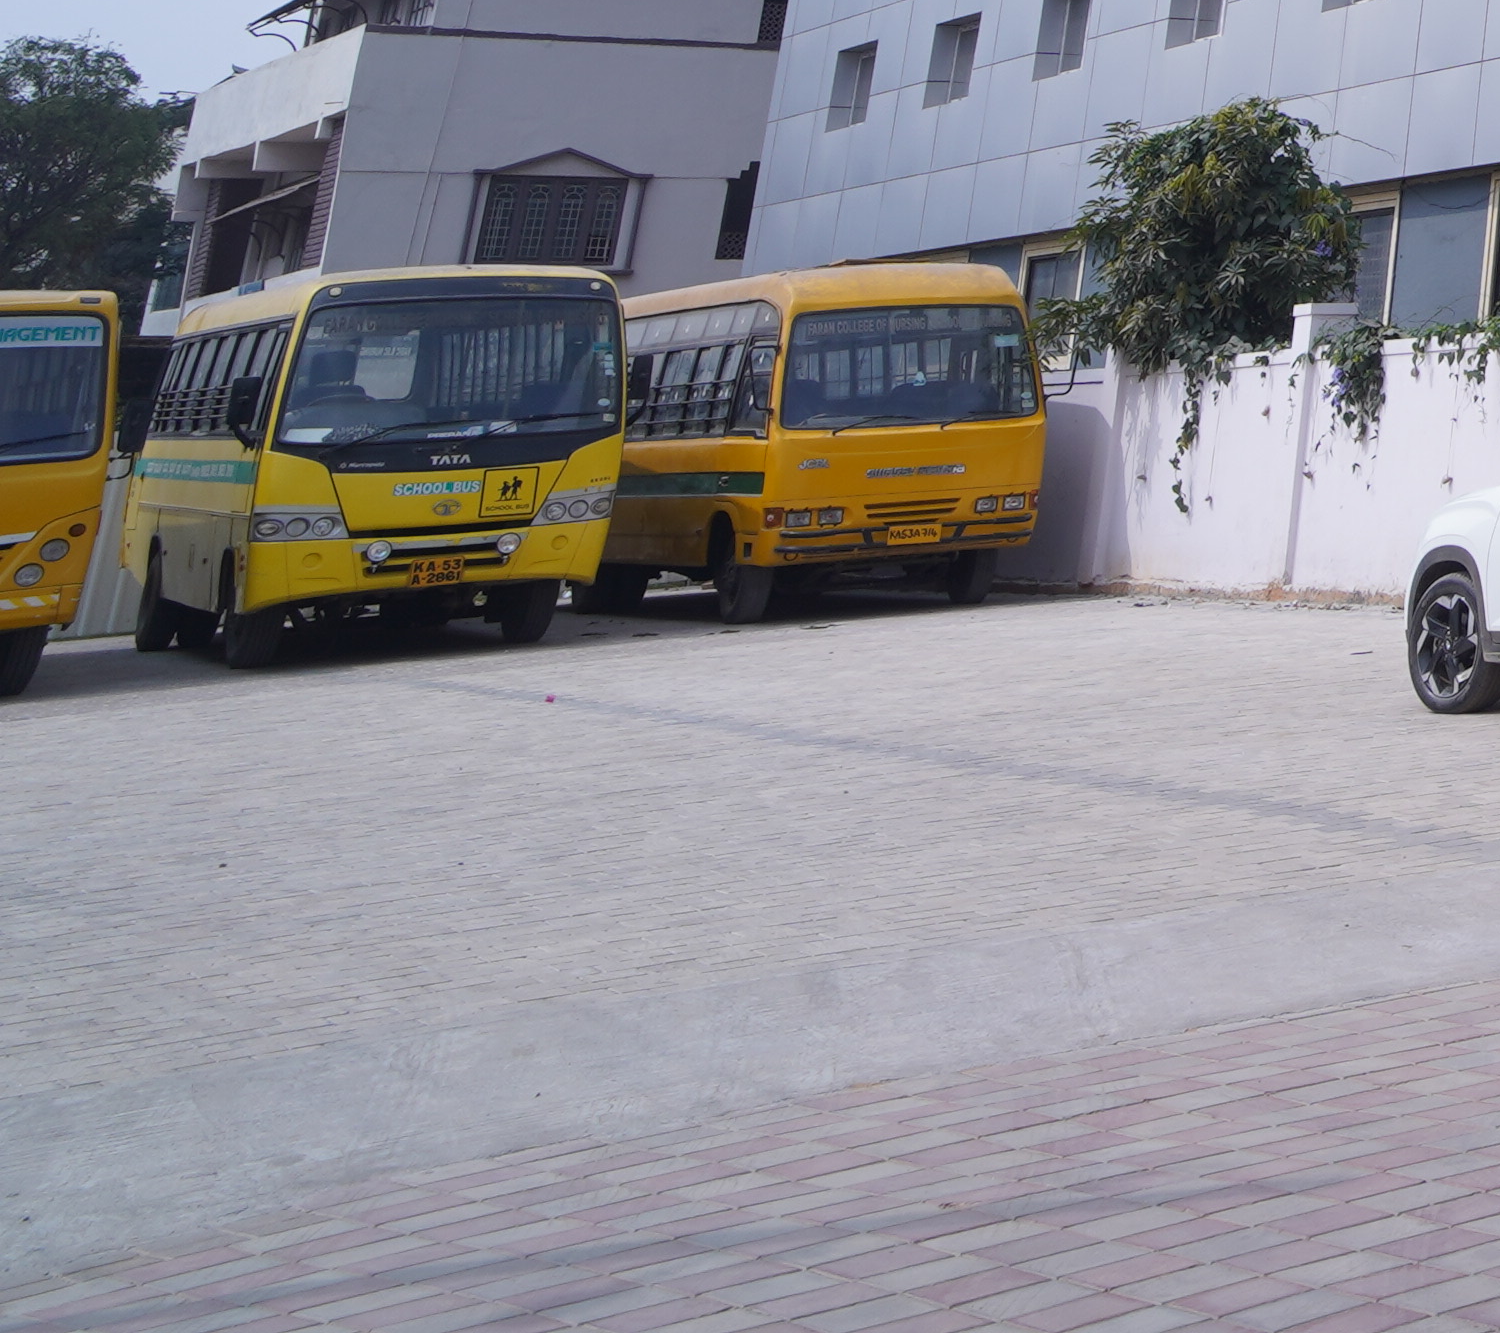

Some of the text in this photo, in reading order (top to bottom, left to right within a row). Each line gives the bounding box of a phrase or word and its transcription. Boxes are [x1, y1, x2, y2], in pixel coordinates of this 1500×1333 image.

[808, 322, 836, 335] FARAN
[430, 454, 472, 465] TATA
[392, 480, 481, 496] SCHOOL BUS
[485, 503, 529, 512] SCHOOL BUS
